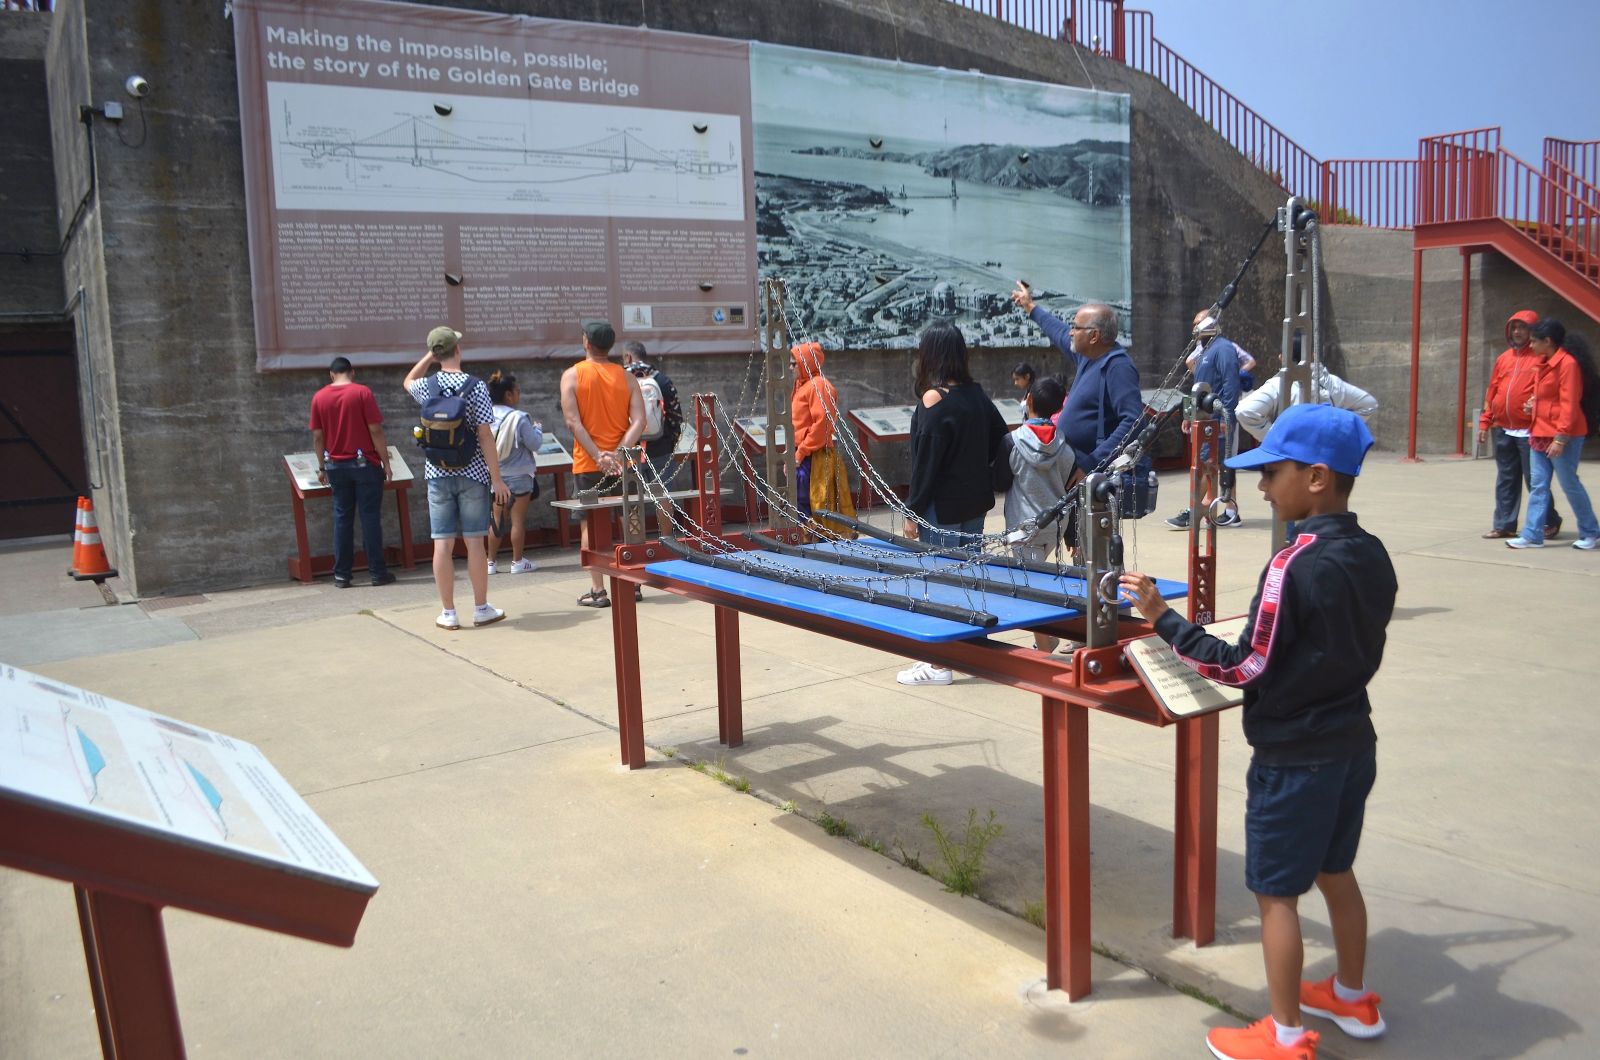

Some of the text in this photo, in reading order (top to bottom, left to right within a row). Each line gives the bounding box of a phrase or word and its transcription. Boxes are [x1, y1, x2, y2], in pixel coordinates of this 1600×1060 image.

[266, 26, 608, 75] Making the impossible, possible;
[267, 52, 640, 97] the story of the Golden Gate Bridge
[1263, 567, 1284, 603] JUMPMAN
[1196, 610, 1212, 625] GGB
